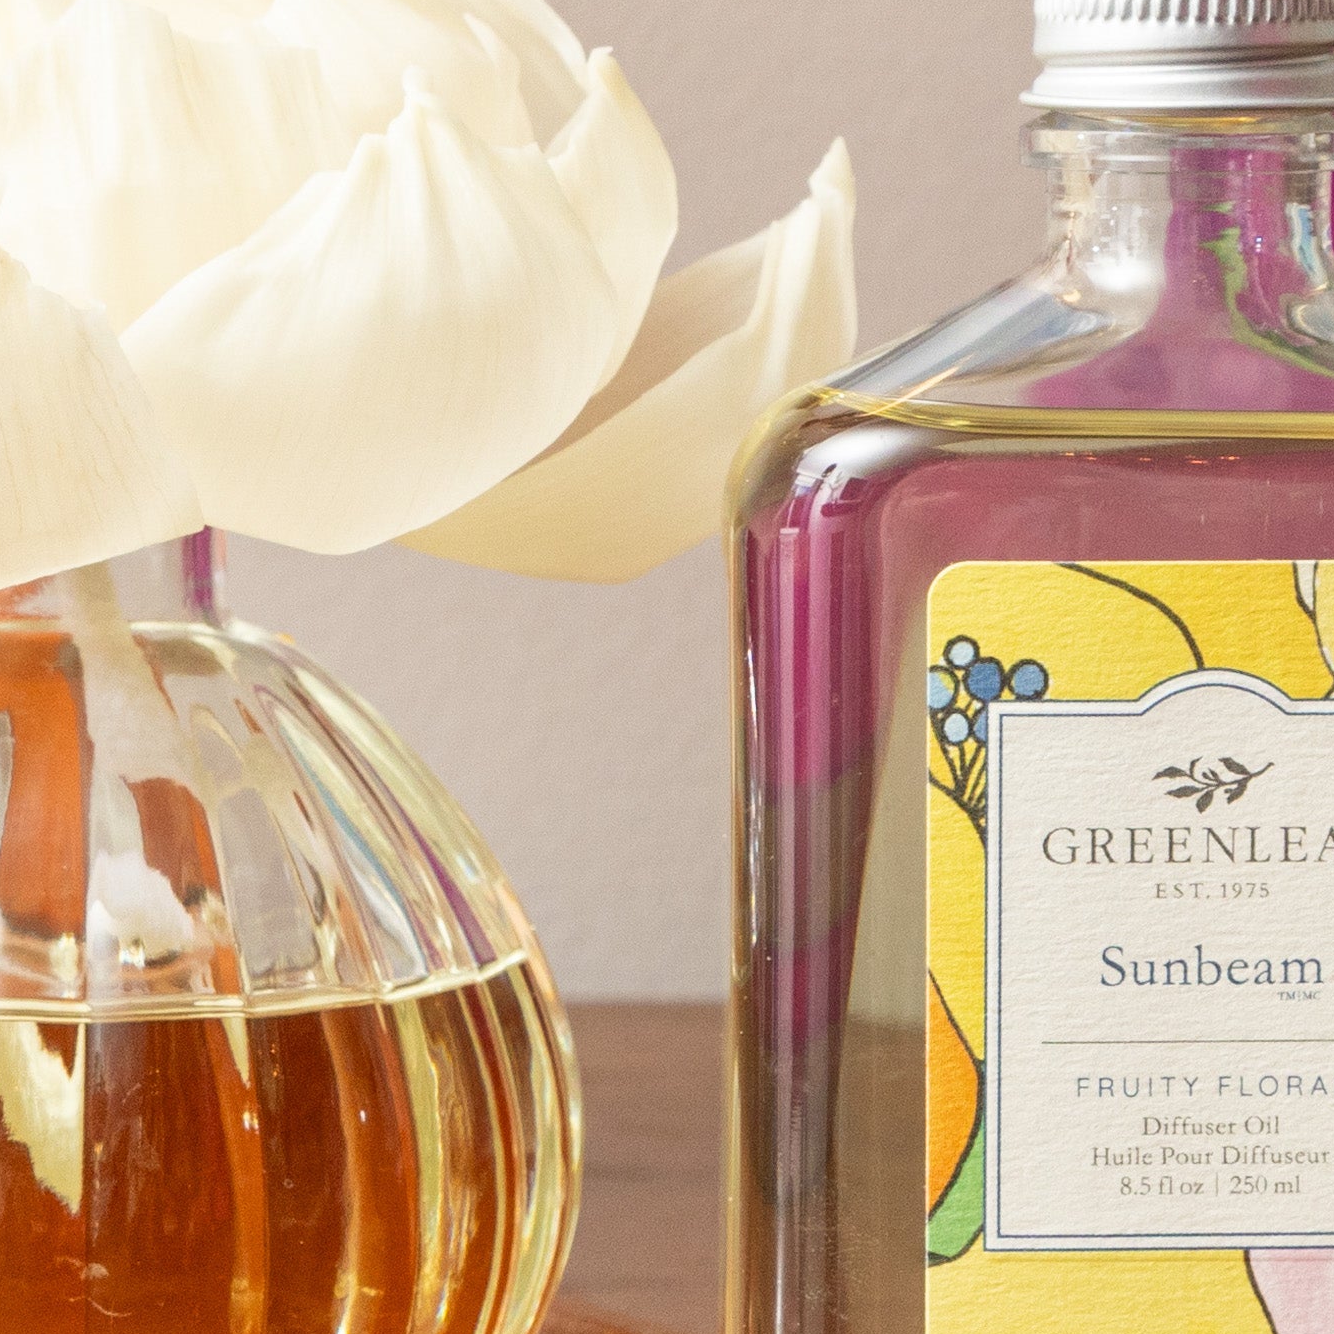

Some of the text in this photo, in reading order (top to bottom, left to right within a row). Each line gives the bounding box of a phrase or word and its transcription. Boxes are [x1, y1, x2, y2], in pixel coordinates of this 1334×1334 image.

[1155, 882, 1270, 900] EST. 1975
[1100, 945, 1324, 987] Sunbeam
[1077, 1076, 1200, 1098] FRUITY
[1141, 1115, 1280, 1136] Diffuser Oil
[1091, 1145, 1330, 1166] Huile Pour Diffuseur
[1120, 1175, 1301, 1196] 8.5 fl oz 250 ml
